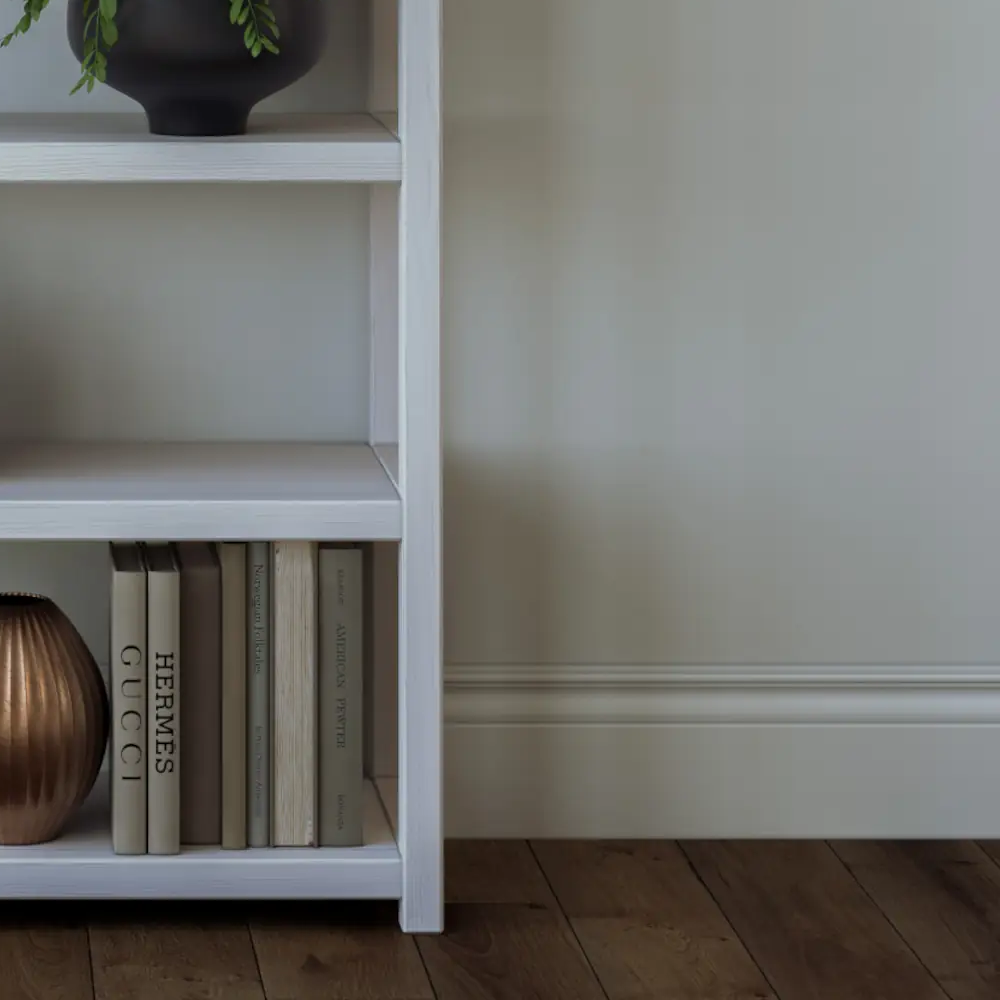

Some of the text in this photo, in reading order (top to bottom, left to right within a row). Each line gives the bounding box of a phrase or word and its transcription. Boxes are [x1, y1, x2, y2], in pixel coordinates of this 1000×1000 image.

[120, 644, 142, 782] GUCCI
[335, 623, 347, 749] AMERICAN PEWTER
